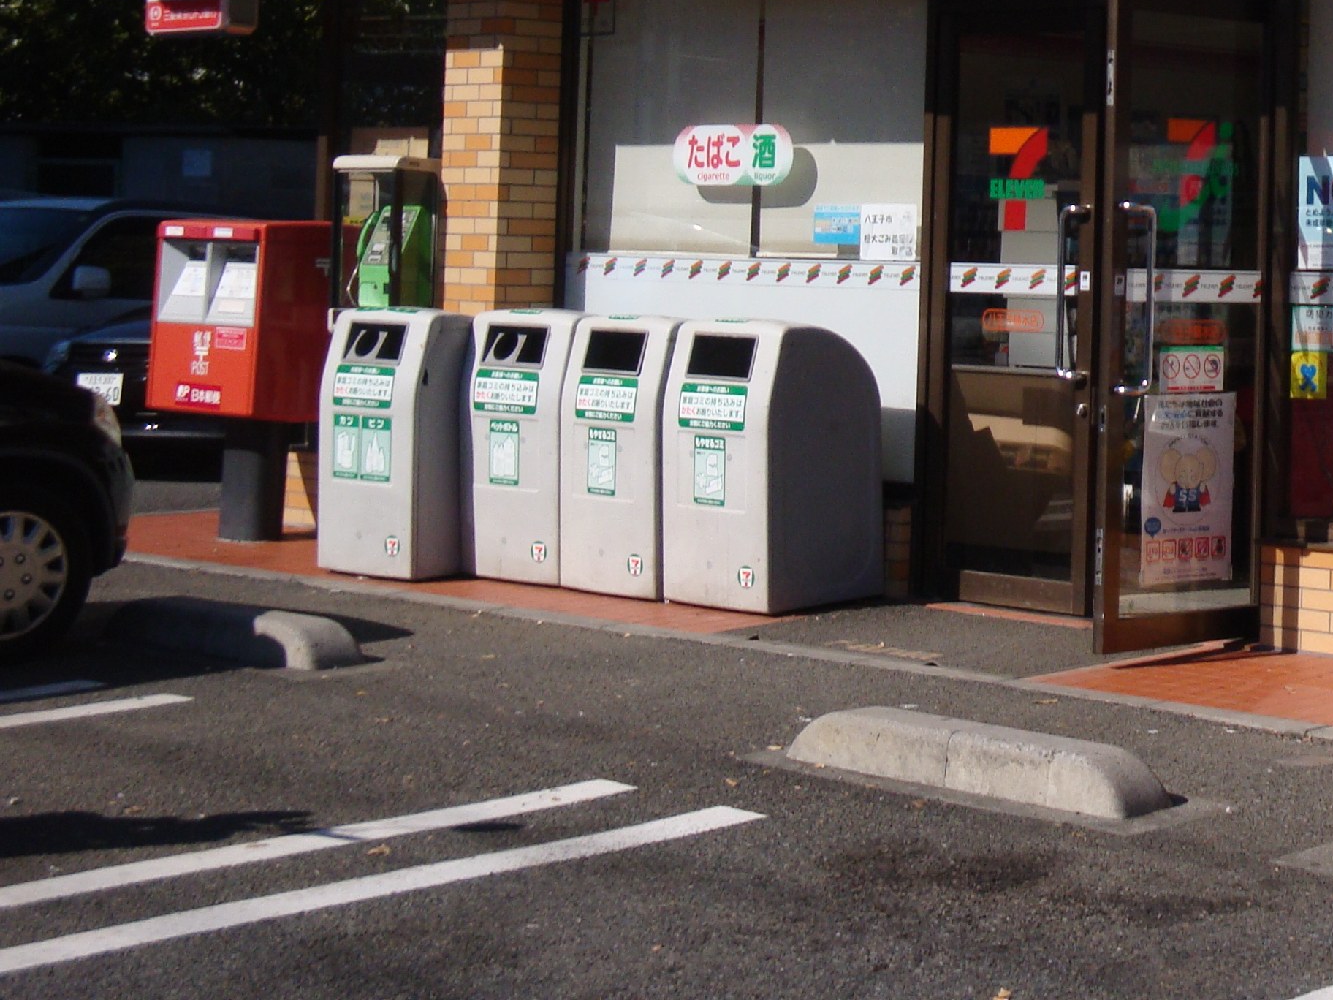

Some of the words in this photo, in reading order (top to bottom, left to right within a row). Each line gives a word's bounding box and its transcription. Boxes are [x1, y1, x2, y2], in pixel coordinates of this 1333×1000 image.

[687, 134, 741, 169] たばこ
[752, 134, 776, 169] 酒
